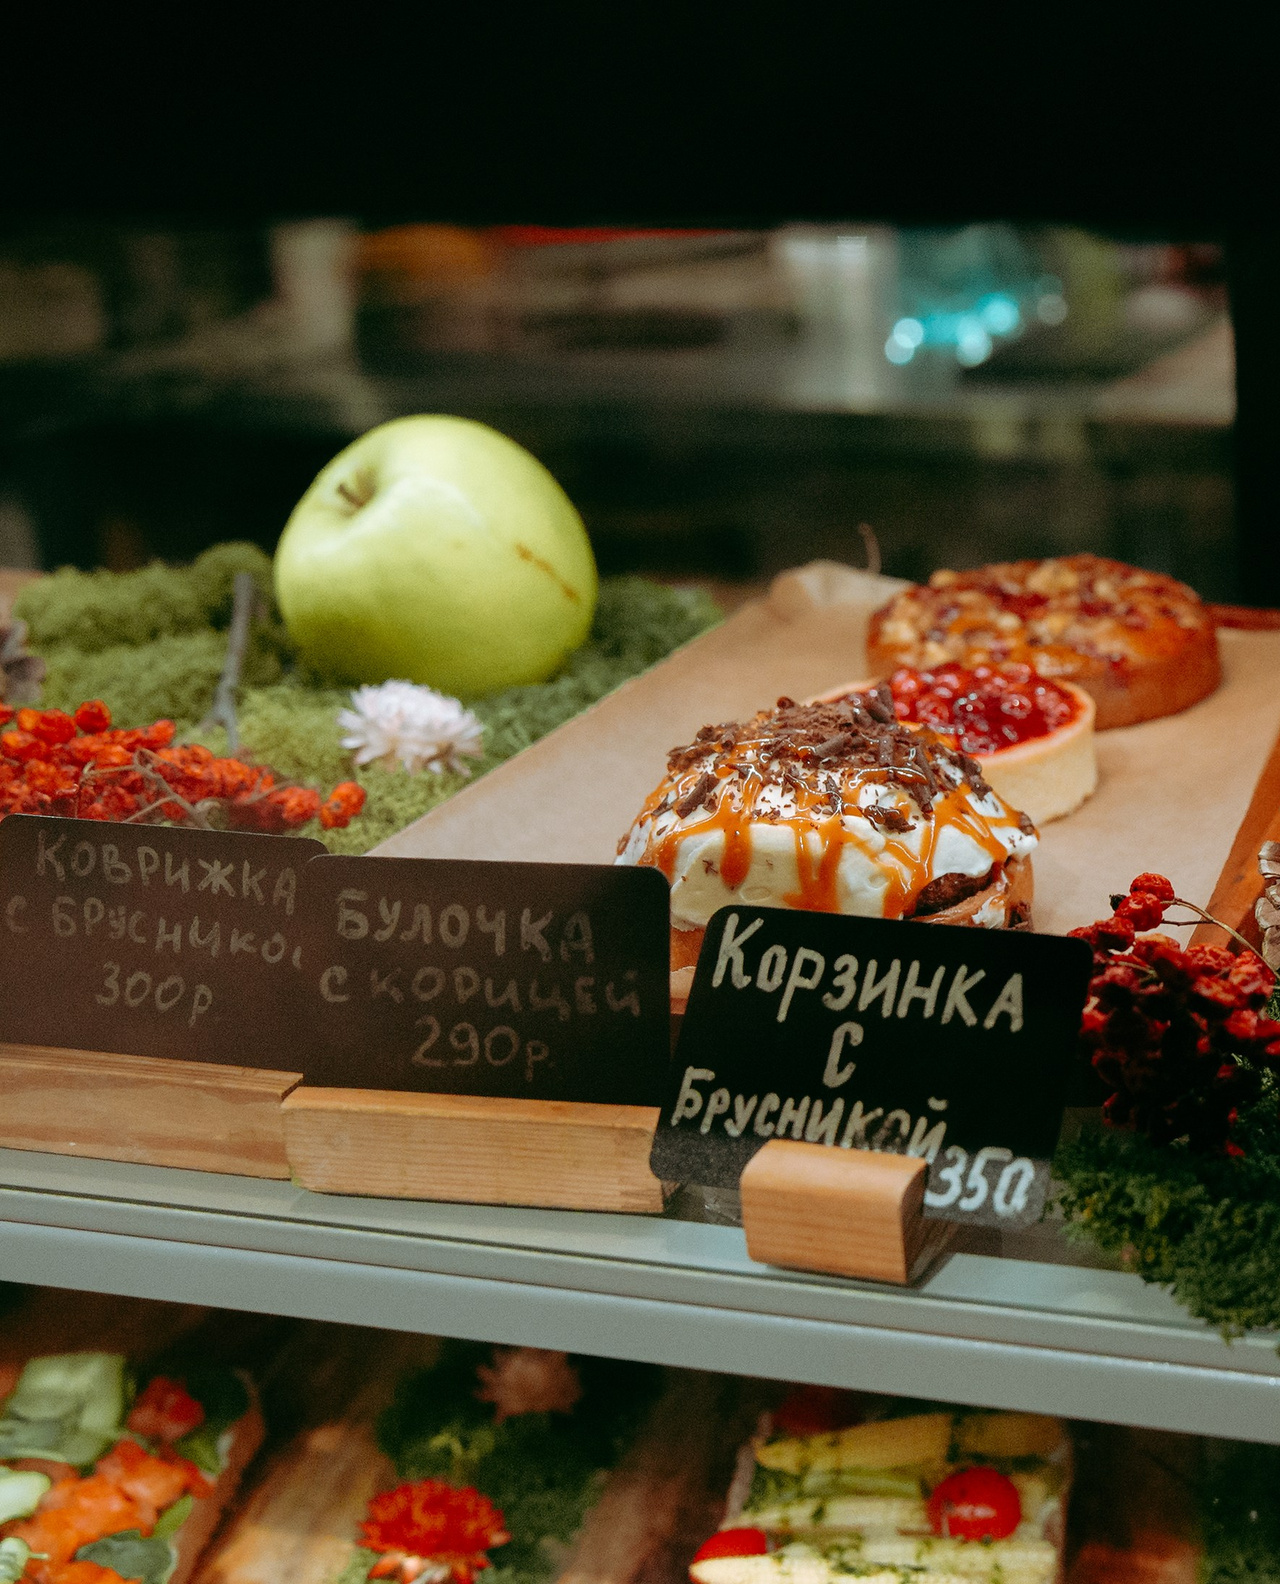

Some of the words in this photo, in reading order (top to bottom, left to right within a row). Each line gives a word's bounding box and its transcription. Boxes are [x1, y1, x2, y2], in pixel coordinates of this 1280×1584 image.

[36, 829, 297, 916] КОВРИЖКА
[335, 888, 595, 964] БУЛОЧКА
[319, 966, 349, 1001] С
[370, 966, 640, 1022] КОРИЦЕЙ
[822, 1021, 864, 1088] С
